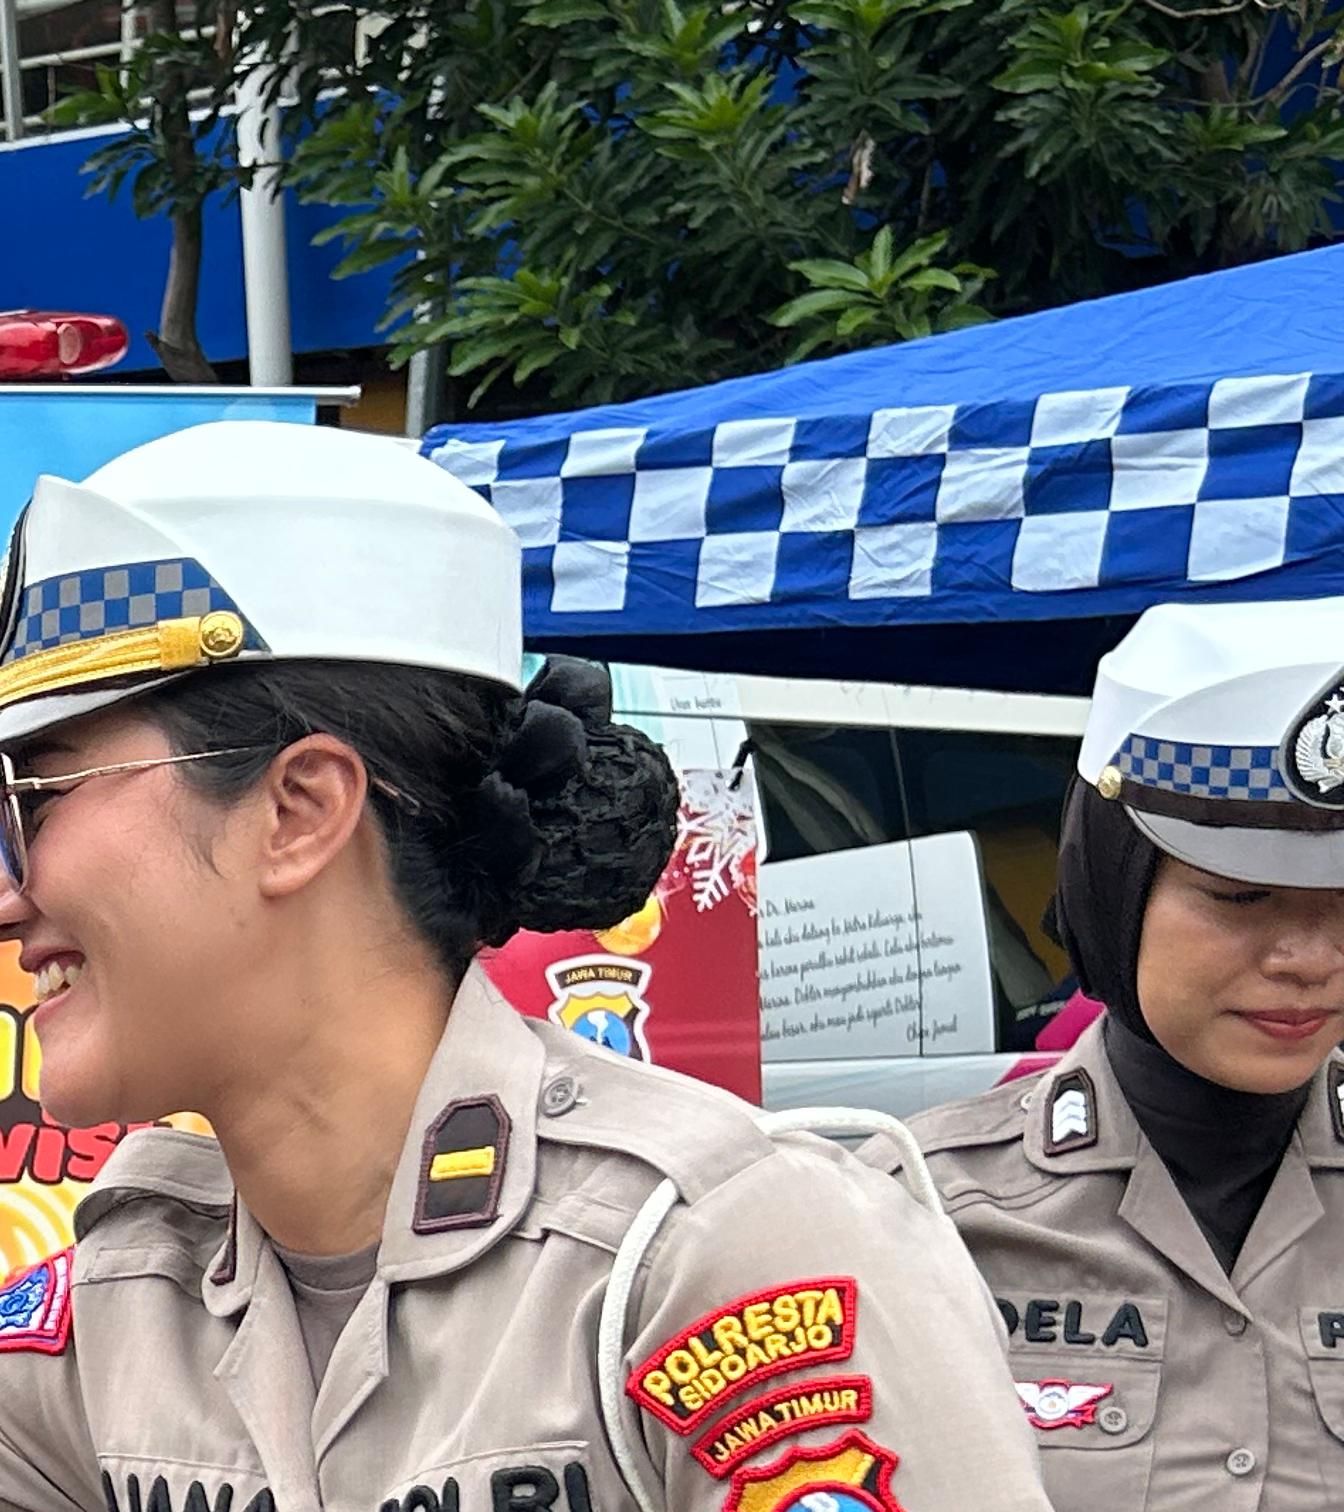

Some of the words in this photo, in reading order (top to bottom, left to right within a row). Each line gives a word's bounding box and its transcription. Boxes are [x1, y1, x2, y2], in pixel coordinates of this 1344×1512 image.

[643, 1288, 844, 1406] POLRESTA
[678, 1324, 834, 1411] SIDOARJO
[713, 1411, 778, 1462] JAWA
[774, 1389, 859, 1424] TIMUR
